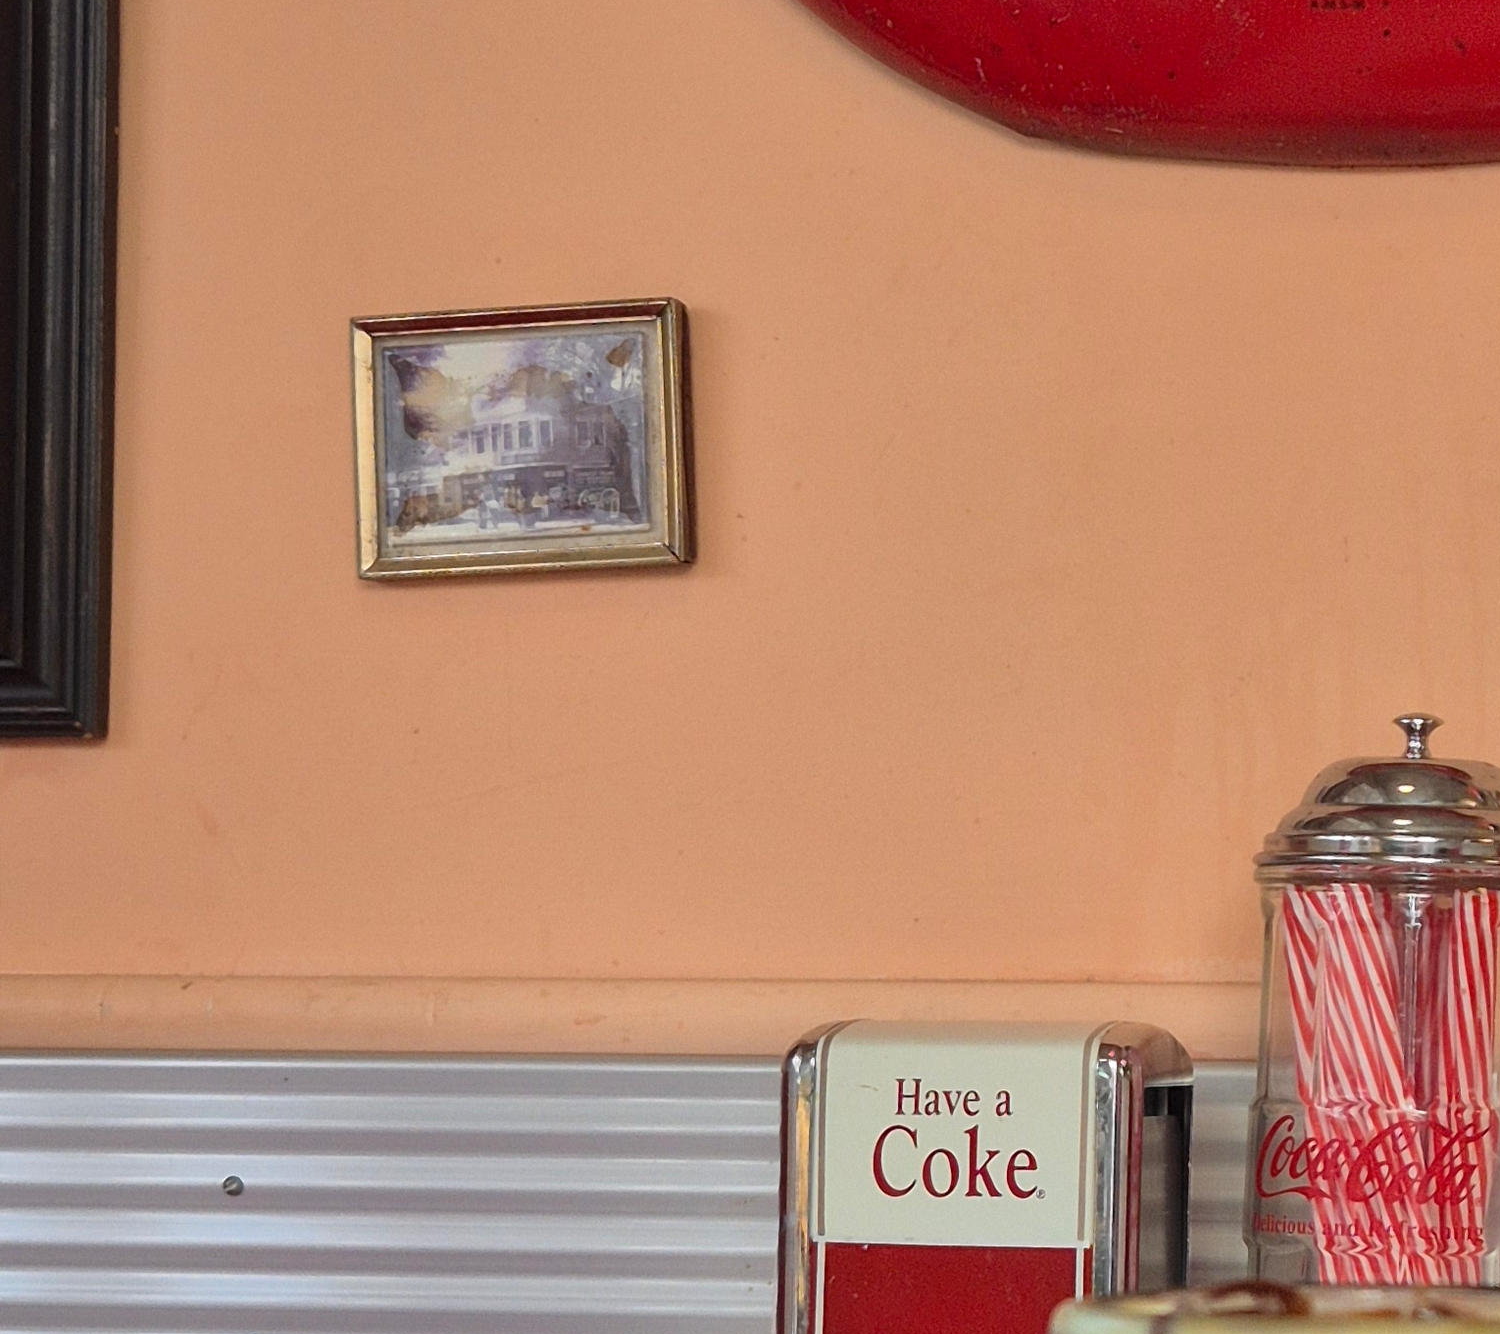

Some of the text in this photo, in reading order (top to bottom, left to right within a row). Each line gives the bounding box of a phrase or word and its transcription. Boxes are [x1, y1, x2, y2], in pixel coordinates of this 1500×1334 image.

[895, 1078, 1013, 1117] Have a
[1256, 1114, 1491, 1206] Coca-Cola
